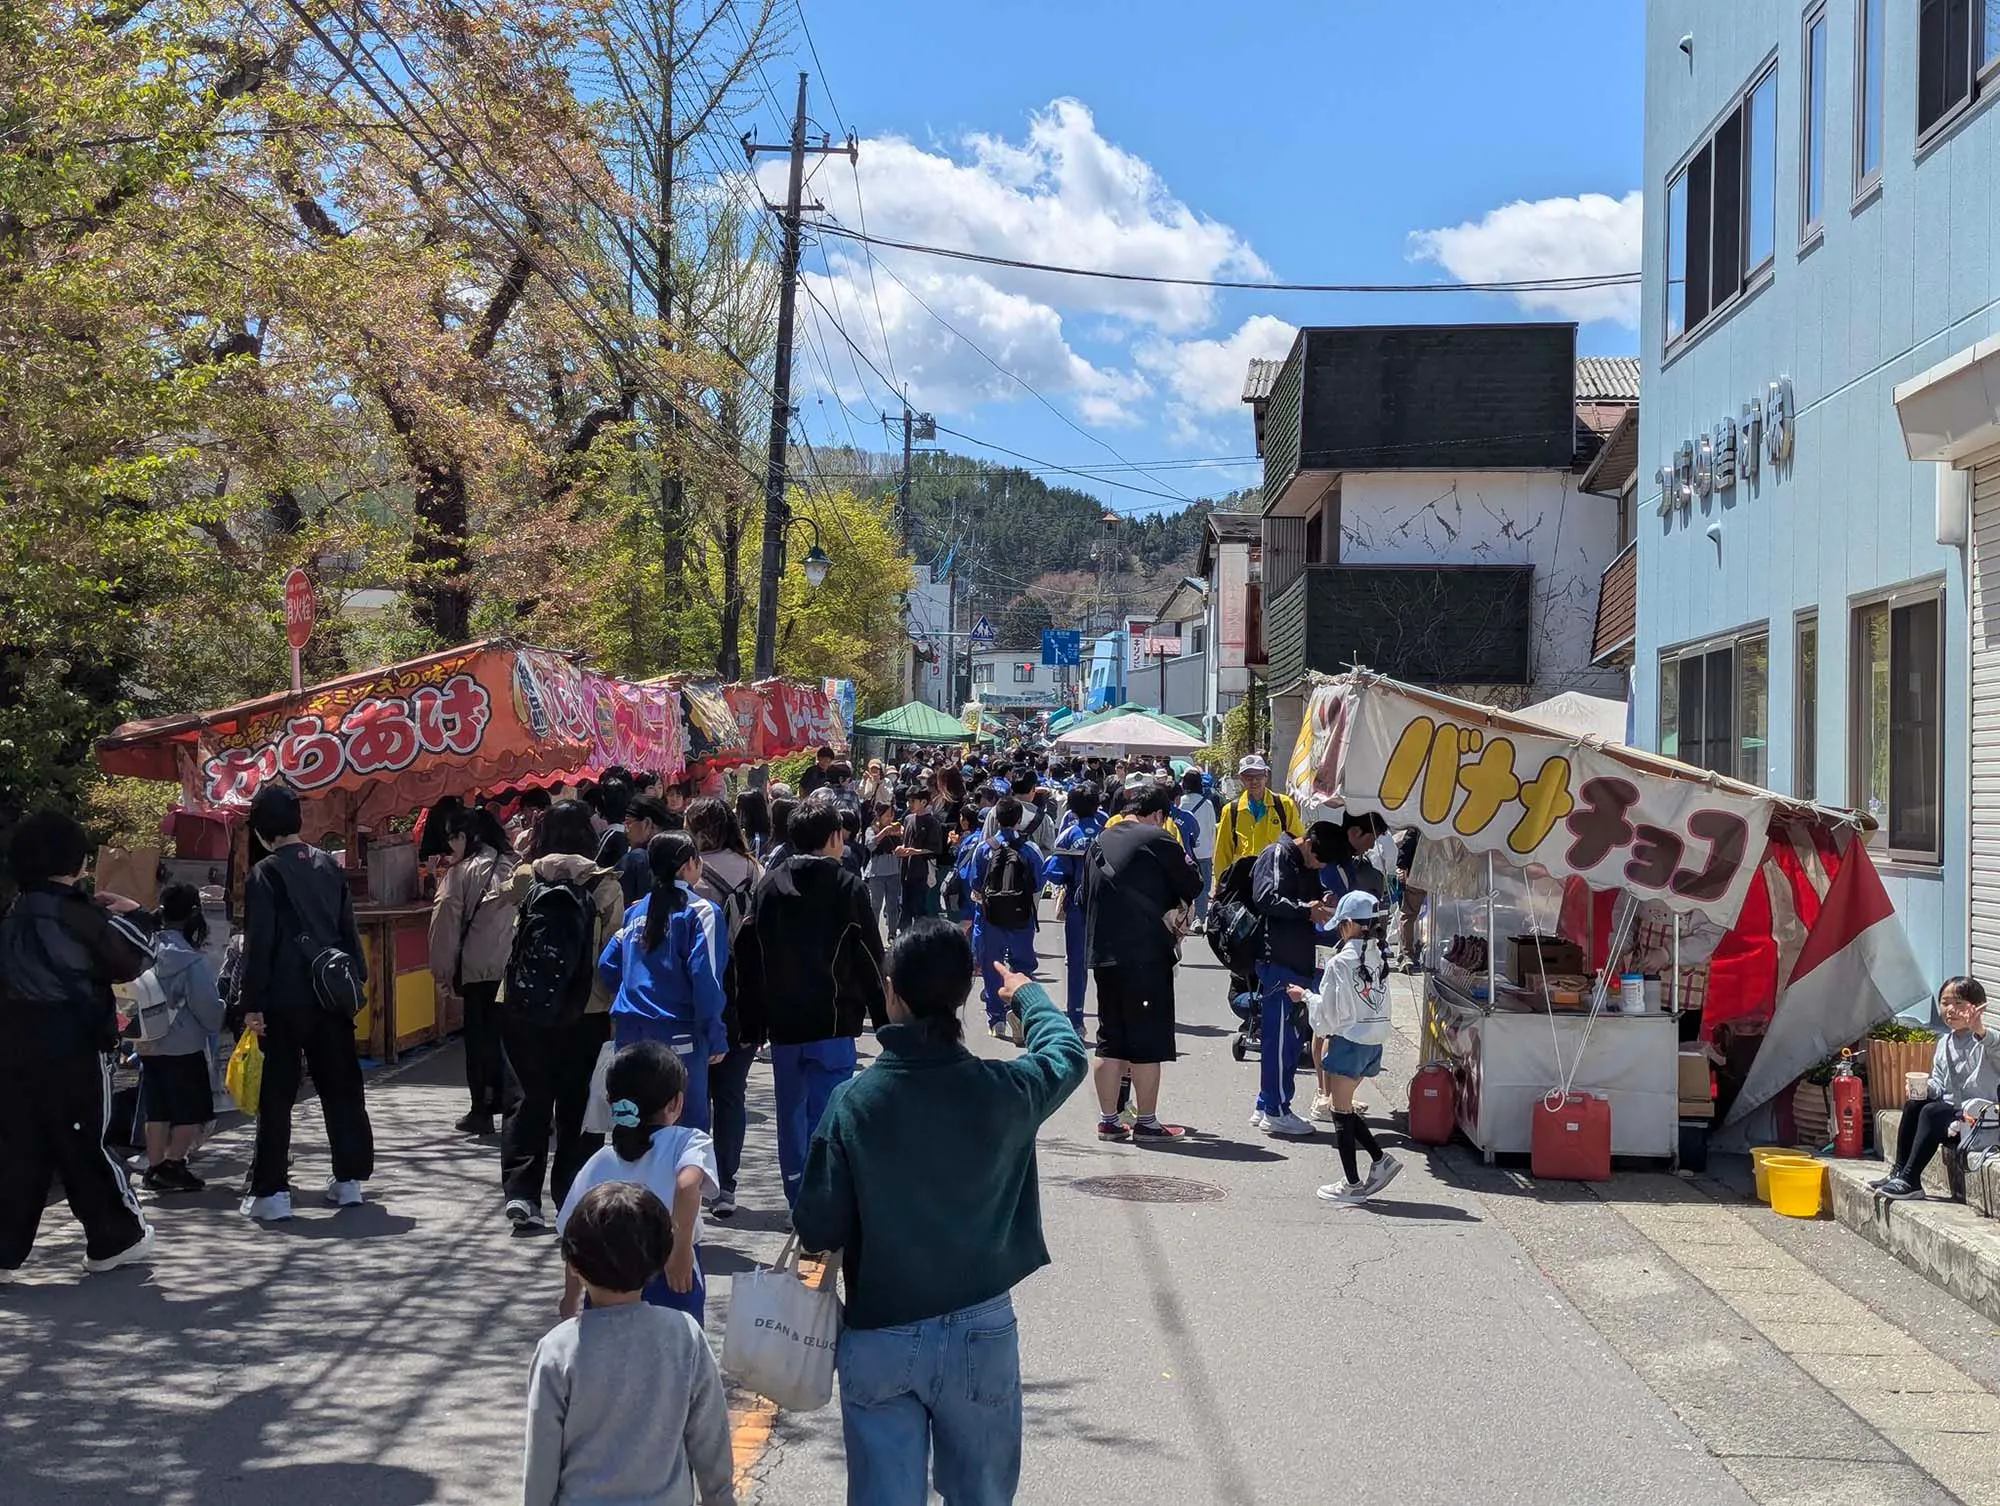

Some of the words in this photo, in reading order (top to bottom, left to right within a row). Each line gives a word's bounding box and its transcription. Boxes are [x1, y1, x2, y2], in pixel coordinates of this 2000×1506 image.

[205, 675, 491, 804] からあげ
[1379, 716, 1748, 901] バナナチョコ
[754, 1318, 791, 1336] DEAN
[792, 1331, 800, 1341] &
